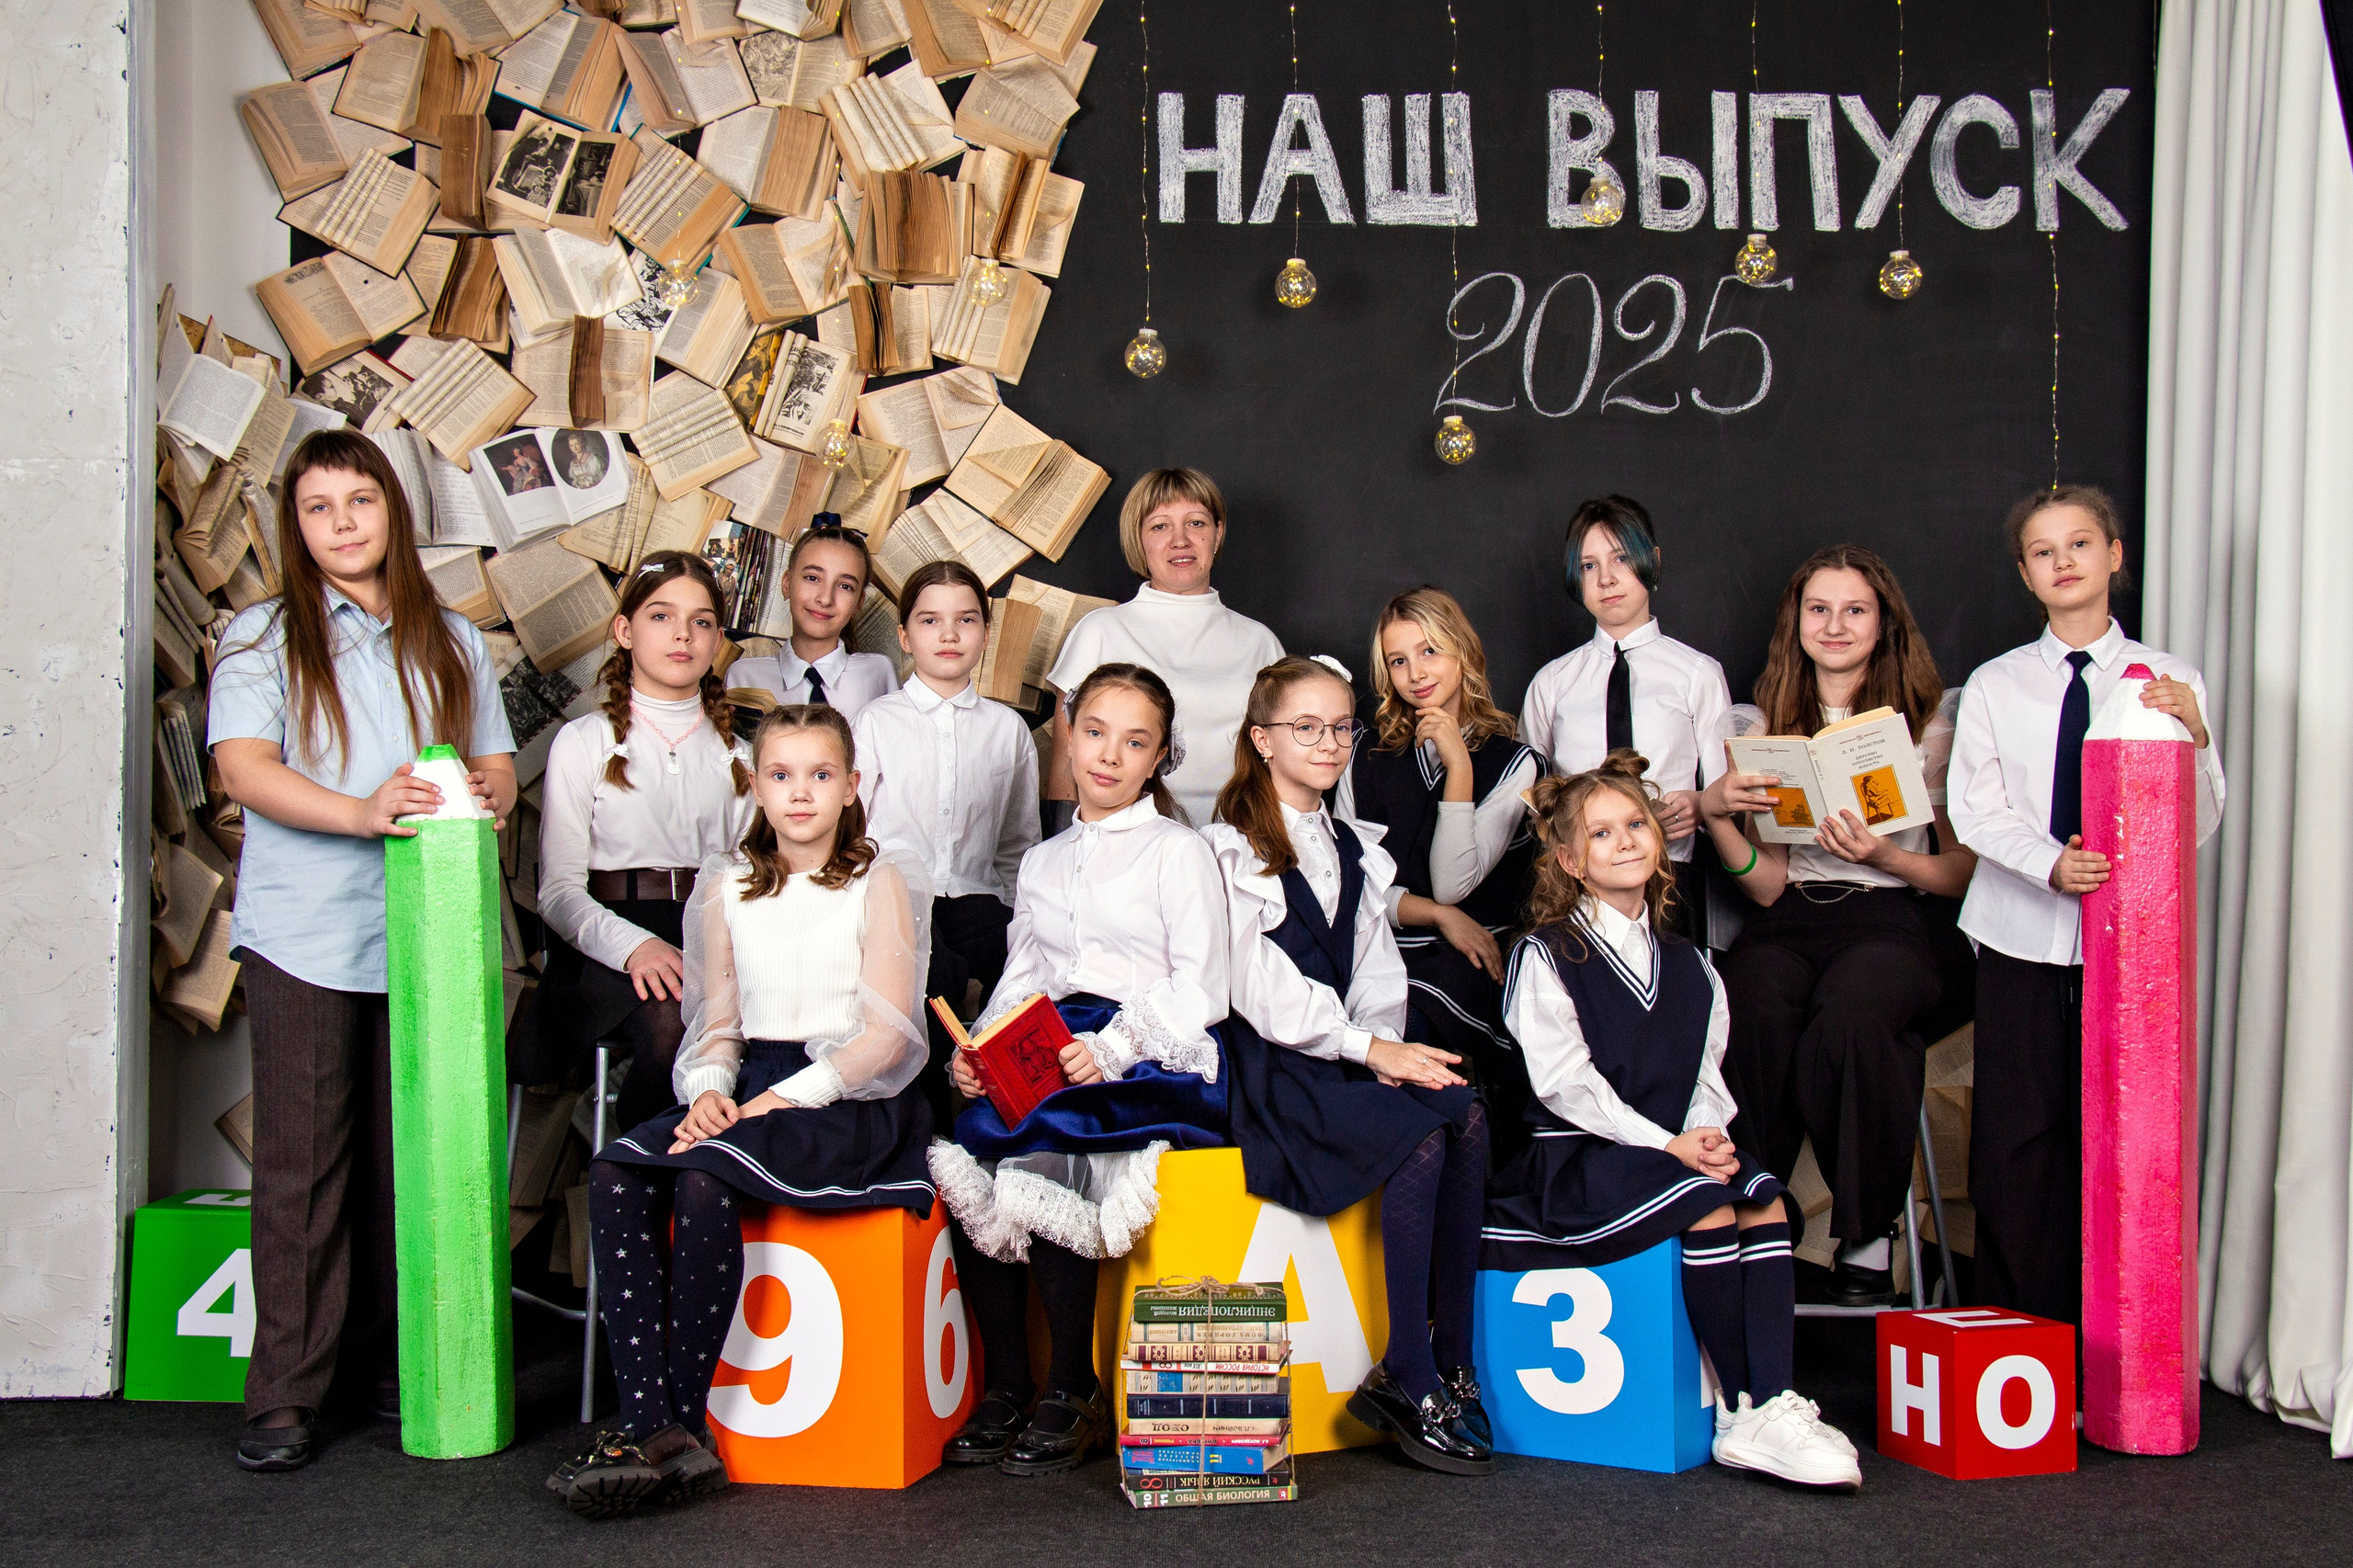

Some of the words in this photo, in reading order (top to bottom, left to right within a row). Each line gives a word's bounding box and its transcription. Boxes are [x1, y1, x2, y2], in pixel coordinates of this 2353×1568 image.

[1157, 92, 1478, 226] НАШ
[1548, 88, 2130, 232] ВЫПУСК
[1434, 272, 1793, 417] 2025
[1858, 738, 1885, 750] ТОЛСТОЙ
[176, 1248, 256, 1358] 4
[923, 1226, 969, 1418] 6
[1178, 1304, 1276, 1317] ЭНЦИКЛОПЕДИЯ
[1237, 1202, 1373, 1393] А
[707, 1242, 844, 1437] 9
[1215, 1362, 1241, 1370] РОССИИ
[1512, 1268, 1624, 1414] 3
[1242, 1364, 1270, 1372] ИСТОРИЯ
[1890, 1344, 1941, 1447] Н
[1976, 1355, 2056, 1449] О
[1139, 1478, 1164, 1489] 8
[1142, 1493, 1153, 1507] 10
[1160, 1493, 1169, 1506] 11
[1212, 1476, 1260, 1487] РУССКИЙ
[1216, 1489, 1270, 1501] БИОЛОГИЯ
